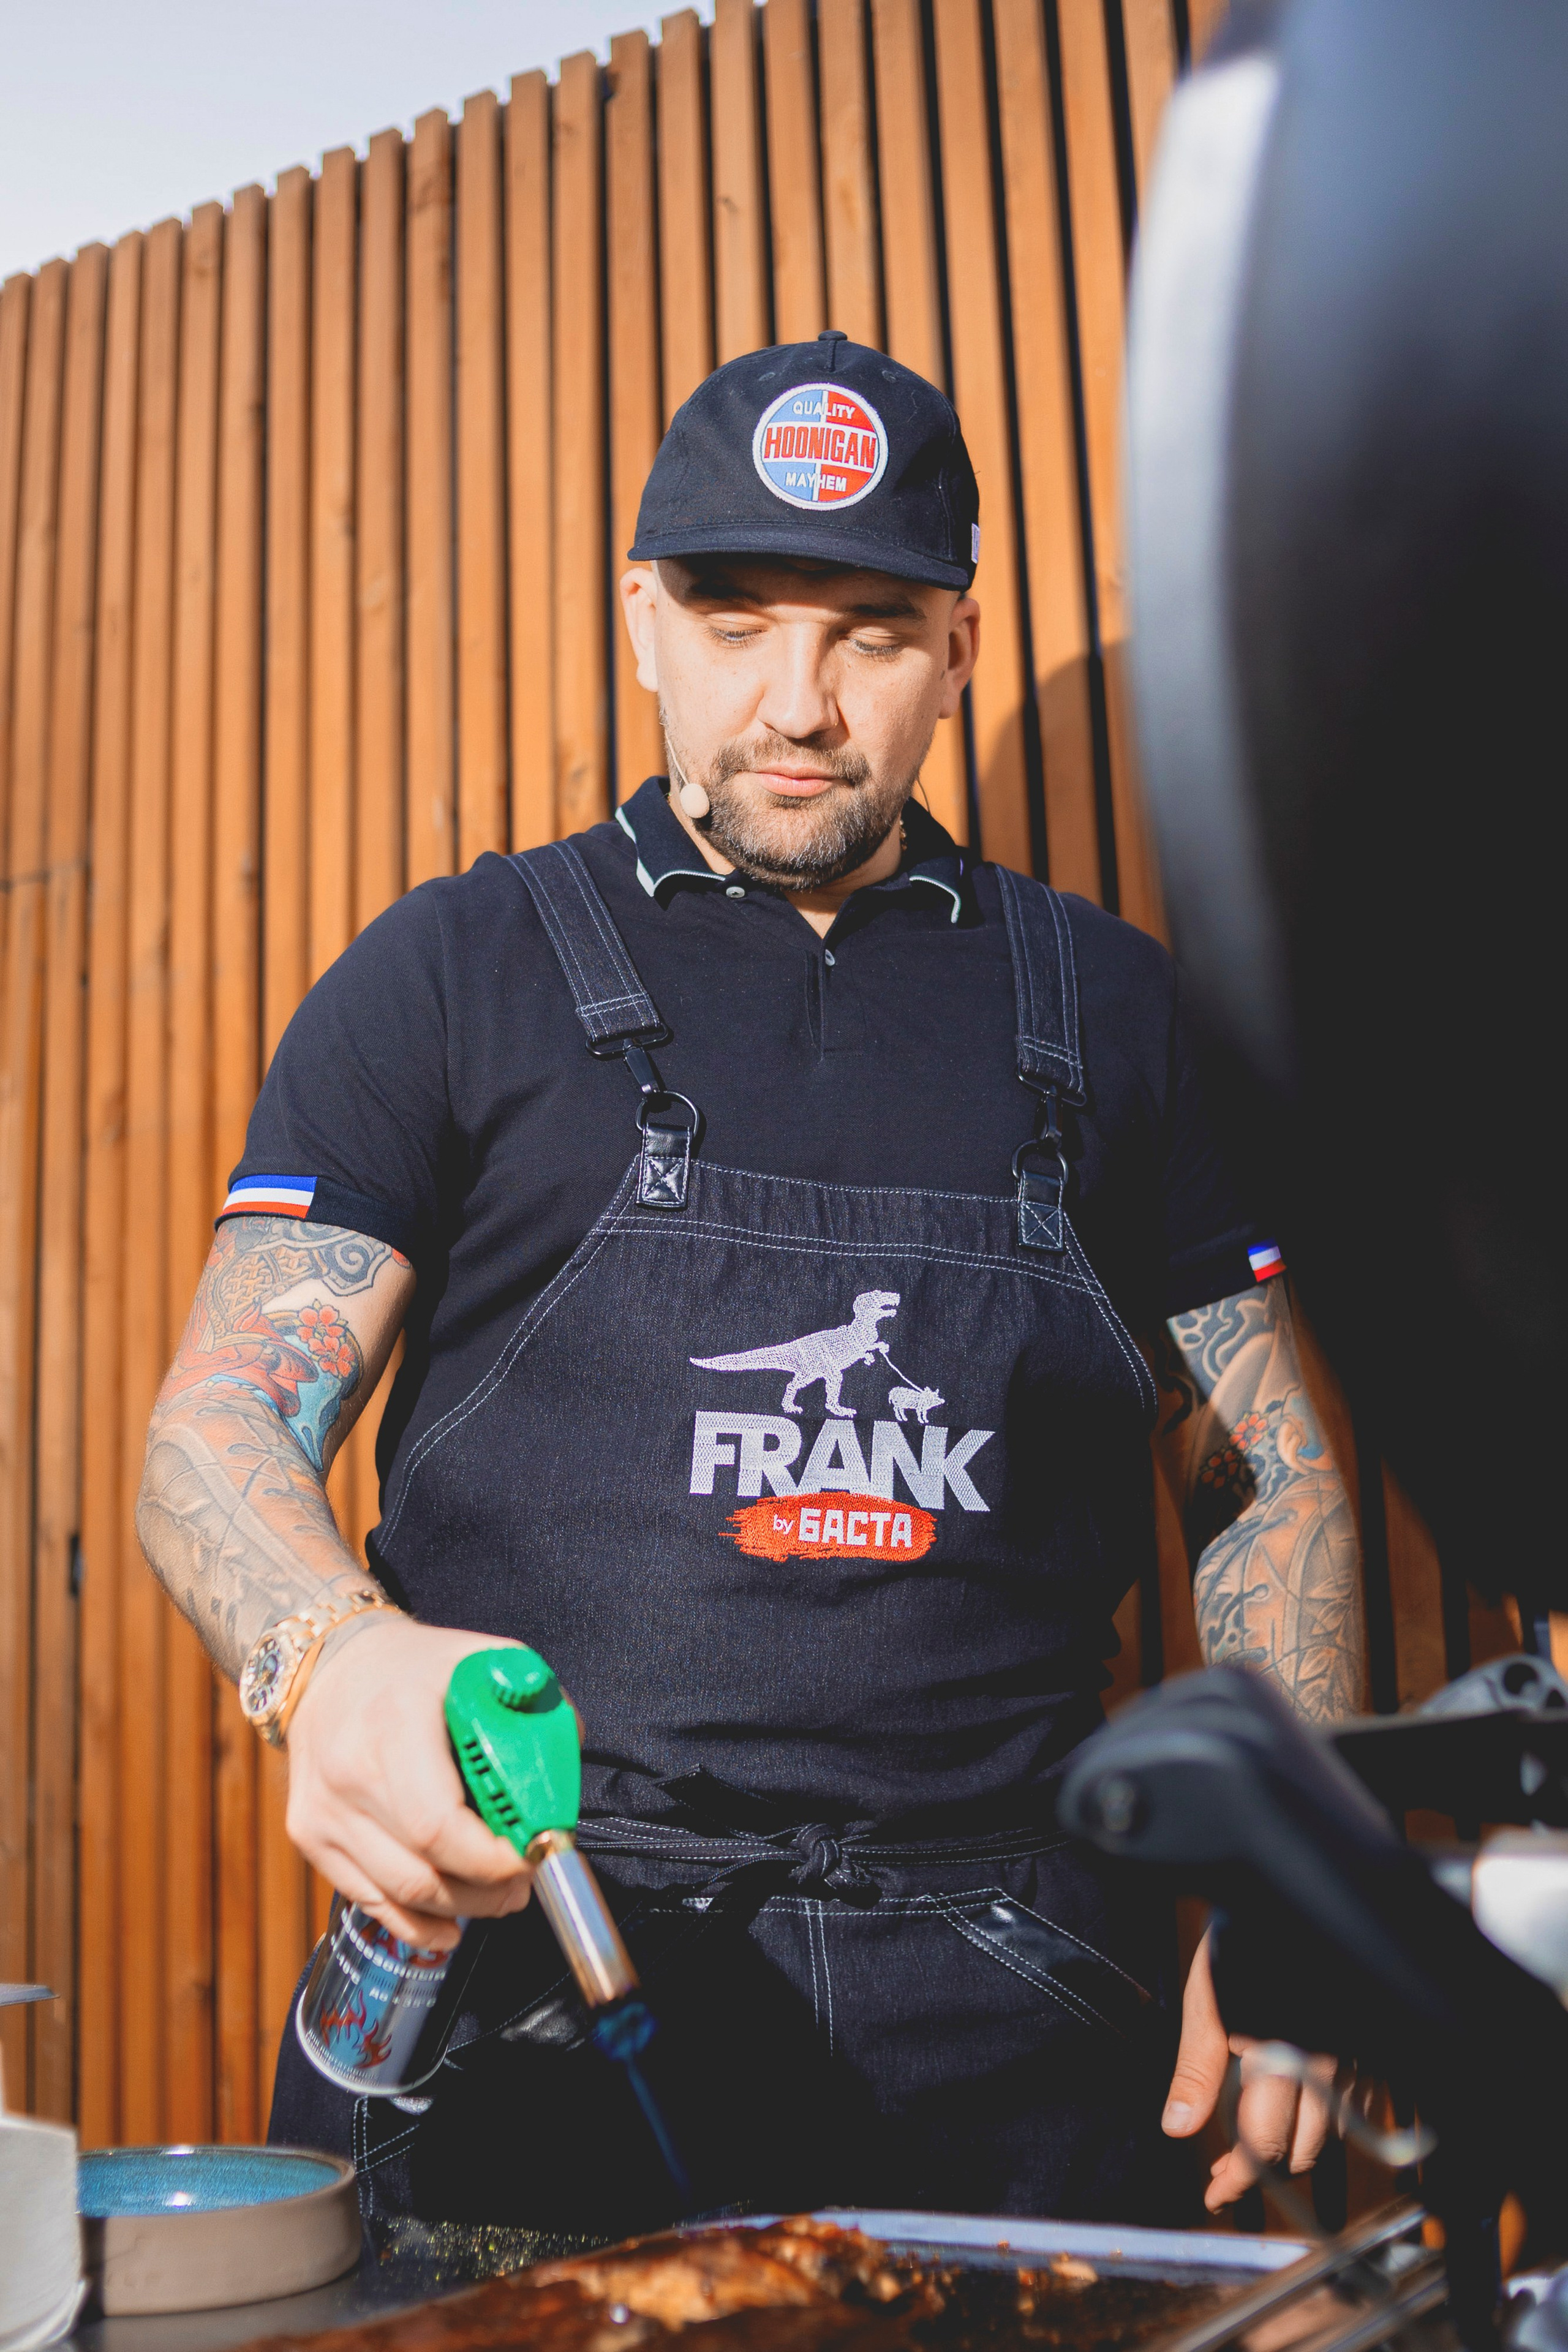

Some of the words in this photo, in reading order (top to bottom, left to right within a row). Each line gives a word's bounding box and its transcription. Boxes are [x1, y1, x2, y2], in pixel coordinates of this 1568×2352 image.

[793, 401, 855, 419] QUALITY
[764, 426, 876, 469] HOONIGAN
[785, 472, 846, 491] MAYHEM
[690, 1411, 995, 1512] FRANK
[773, 1515, 794, 1535] by
